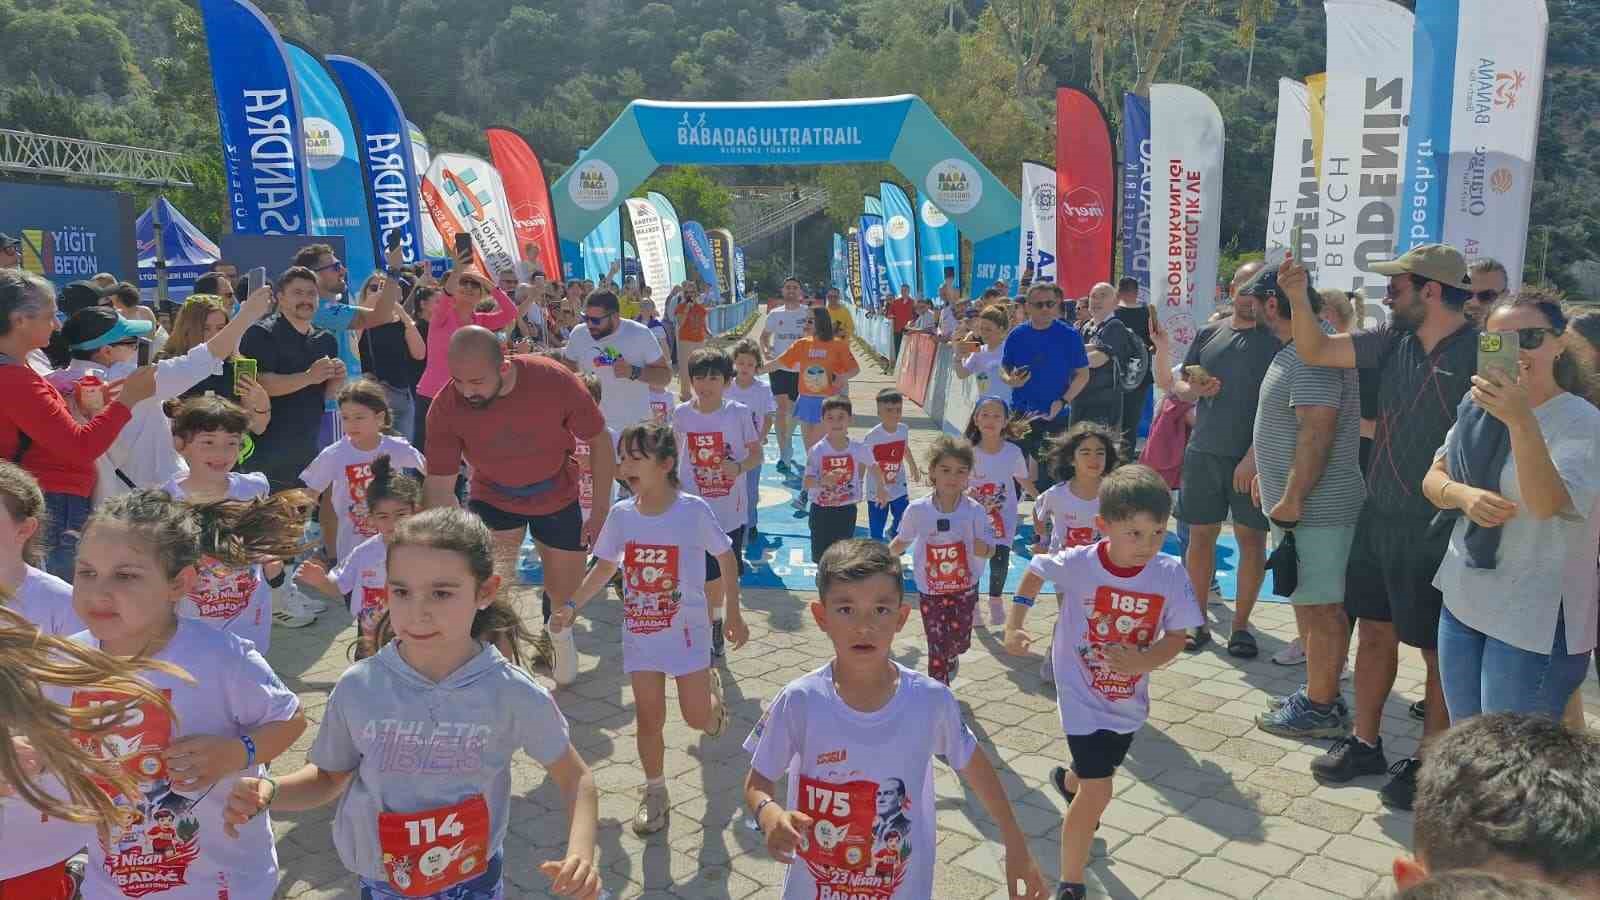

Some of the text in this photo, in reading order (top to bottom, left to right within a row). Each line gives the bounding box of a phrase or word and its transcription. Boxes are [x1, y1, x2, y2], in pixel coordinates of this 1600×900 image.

[677, 126, 757, 146] BABADAĞ
[51, 225, 97, 253] YİĞİT
[54, 255, 98, 275] BETON
[634, 548, 667, 563] 222
[930, 547, 958, 560] 176
[1110, 592, 1150, 614] 185
[806, 785, 850, 817] 175
[404, 812, 464, 847] 114
[122, 853, 163, 867] Nisan
[831, 871, 848, 884] 23
